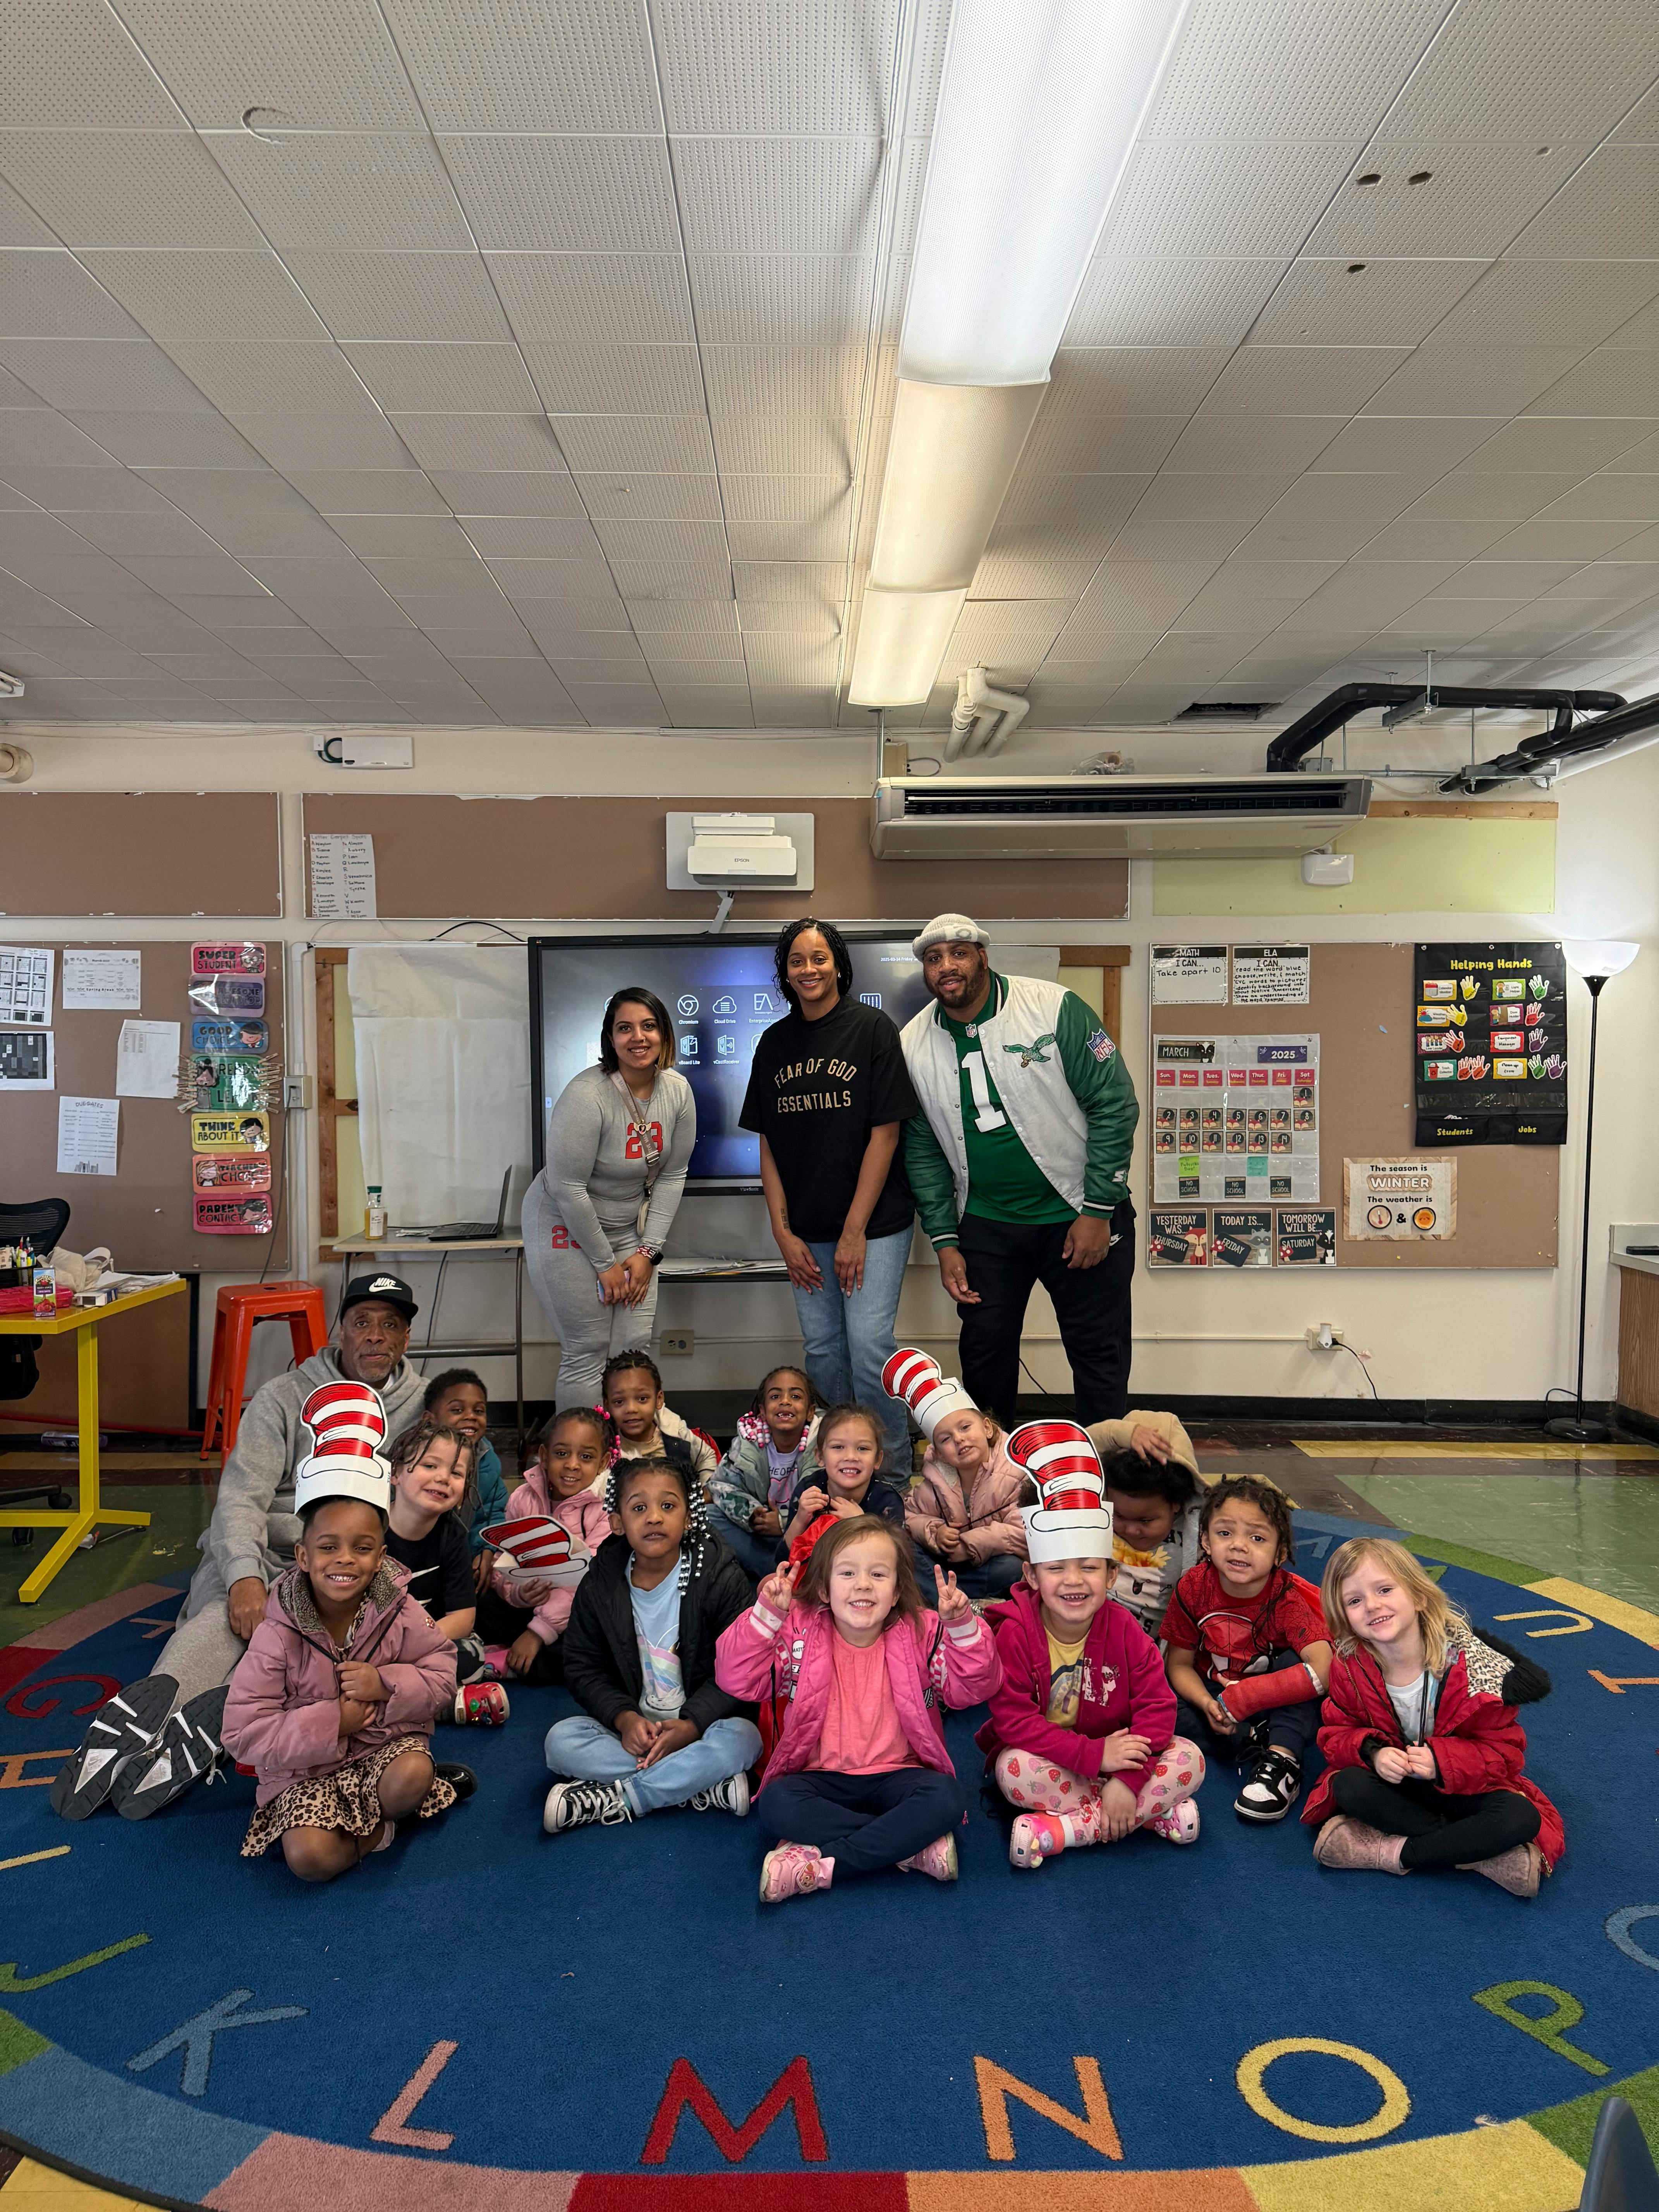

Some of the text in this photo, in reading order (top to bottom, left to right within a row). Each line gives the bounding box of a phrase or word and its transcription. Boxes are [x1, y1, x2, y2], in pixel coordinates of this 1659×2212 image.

[198, 950, 236, 960] SUPER
[1264, 949, 1278, 957] ELA
[198, 960, 237, 969] STUDENT
[1450, 958, 1532, 971] Helping Hands
[1182, 968, 1208, 977] apart
[199, 1026, 232, 1035] GOOD
[1095, 1038, 1113, 1060] NFL
[1162, 1047, 1189, 1058] MARCH
[1271, 1050, 1296, 1059] 2025
[774, 1058, 857, 1089] FEAR OF GOD
[961, 1050, 1007, 1133] 1
[778, 1090, 851, 1113] ESSENTIALS
[199, 1121, 235, 1132] THINK
[198, 1132, 228, 1141] ABOUT
[625, 1121, 663, 1159] 23
[1189, 1135, 1195, 1143] 10
[1213, 1134, 1217, 1142] 11
[1235, 1135, 1242, 1143] 12
[1258, 1135, 1264, 1143] 13
[1281, 1135, 1287, 1143] 14
[1370, 1176, 1430, 1189] WINTER
[199, 1204, 242, 1213] PARENT
[199, 1213, 242, 1223] CONTACT
[1156, 1215, 1197, 1226] YESTERDAY
[1221, 1216, 1264, 1226] TODAY IS...
[1282, 1214, 1325, 1224] TOMORROW
[1396, 1213, 1407, 1223] &
[1164, 1225, 1187, 1235] WAS...
[1285, 1223, 1322, 1233] WILL BE...
[1154, 1234, 1188, 1252] THURSDAY
[1221, 1238, 1245, 1255] FRIDAY
[1281, 1238, 1315, 1249] SATURDAY
[374, 1277, 397, 1287] NIKE
[1492, 1609, 1594, 1637] U
[1470, 1980, 1613, 2077] P
[126, 1987, 310, 2096] K
[369, 2039, 460, 2151] L
[1236, 2037, 1412, 2143] O
[640, 2056, 830, 2165] M
[973, 2056, 1125, 2162] N
